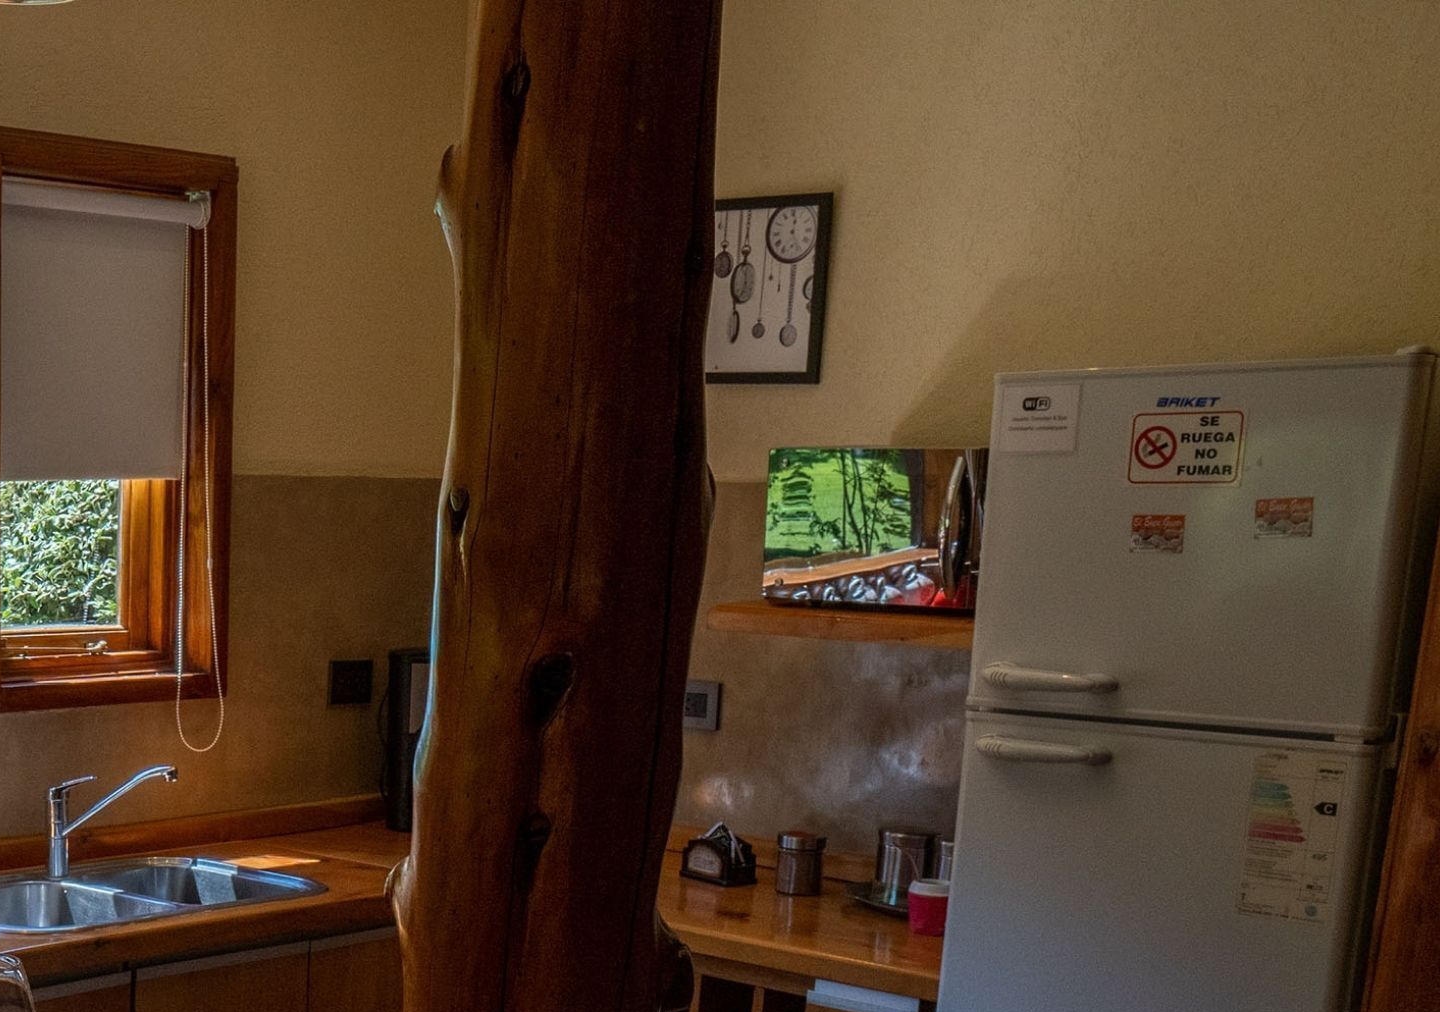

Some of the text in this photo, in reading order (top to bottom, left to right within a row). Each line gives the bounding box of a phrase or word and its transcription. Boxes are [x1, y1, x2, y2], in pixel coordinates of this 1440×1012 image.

[1156, 396, 1221, 408] BRIKET
[1200, 416, 1220, 427] SE
[1180, 432, 1236, 443] RUEGA
[1195, 448, 1218, 459] NO
[1177, 465, 1232, 476] FUMAR
